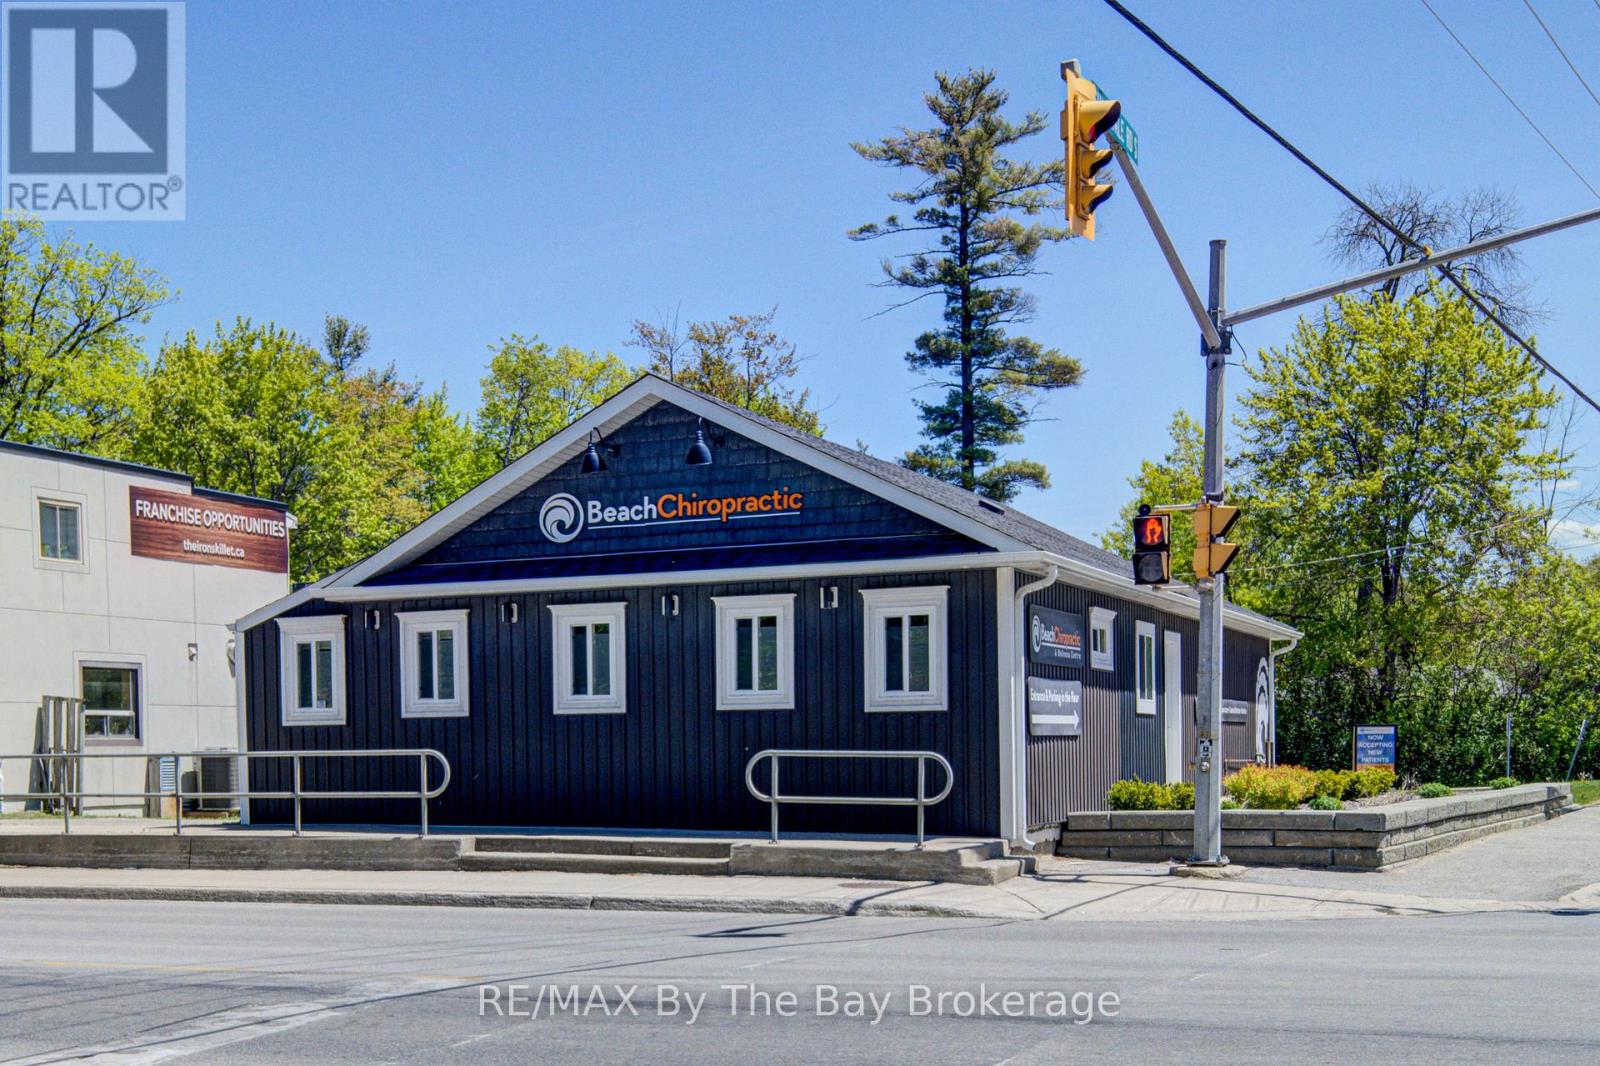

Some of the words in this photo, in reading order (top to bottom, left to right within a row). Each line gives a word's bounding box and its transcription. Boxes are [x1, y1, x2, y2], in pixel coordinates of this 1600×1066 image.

[135, 499, 202, 526] FRANCHISE
[203, 509, 286, 537] OPPORTUNITIES
[182, 538, 245, 559] theironskillet.ca
